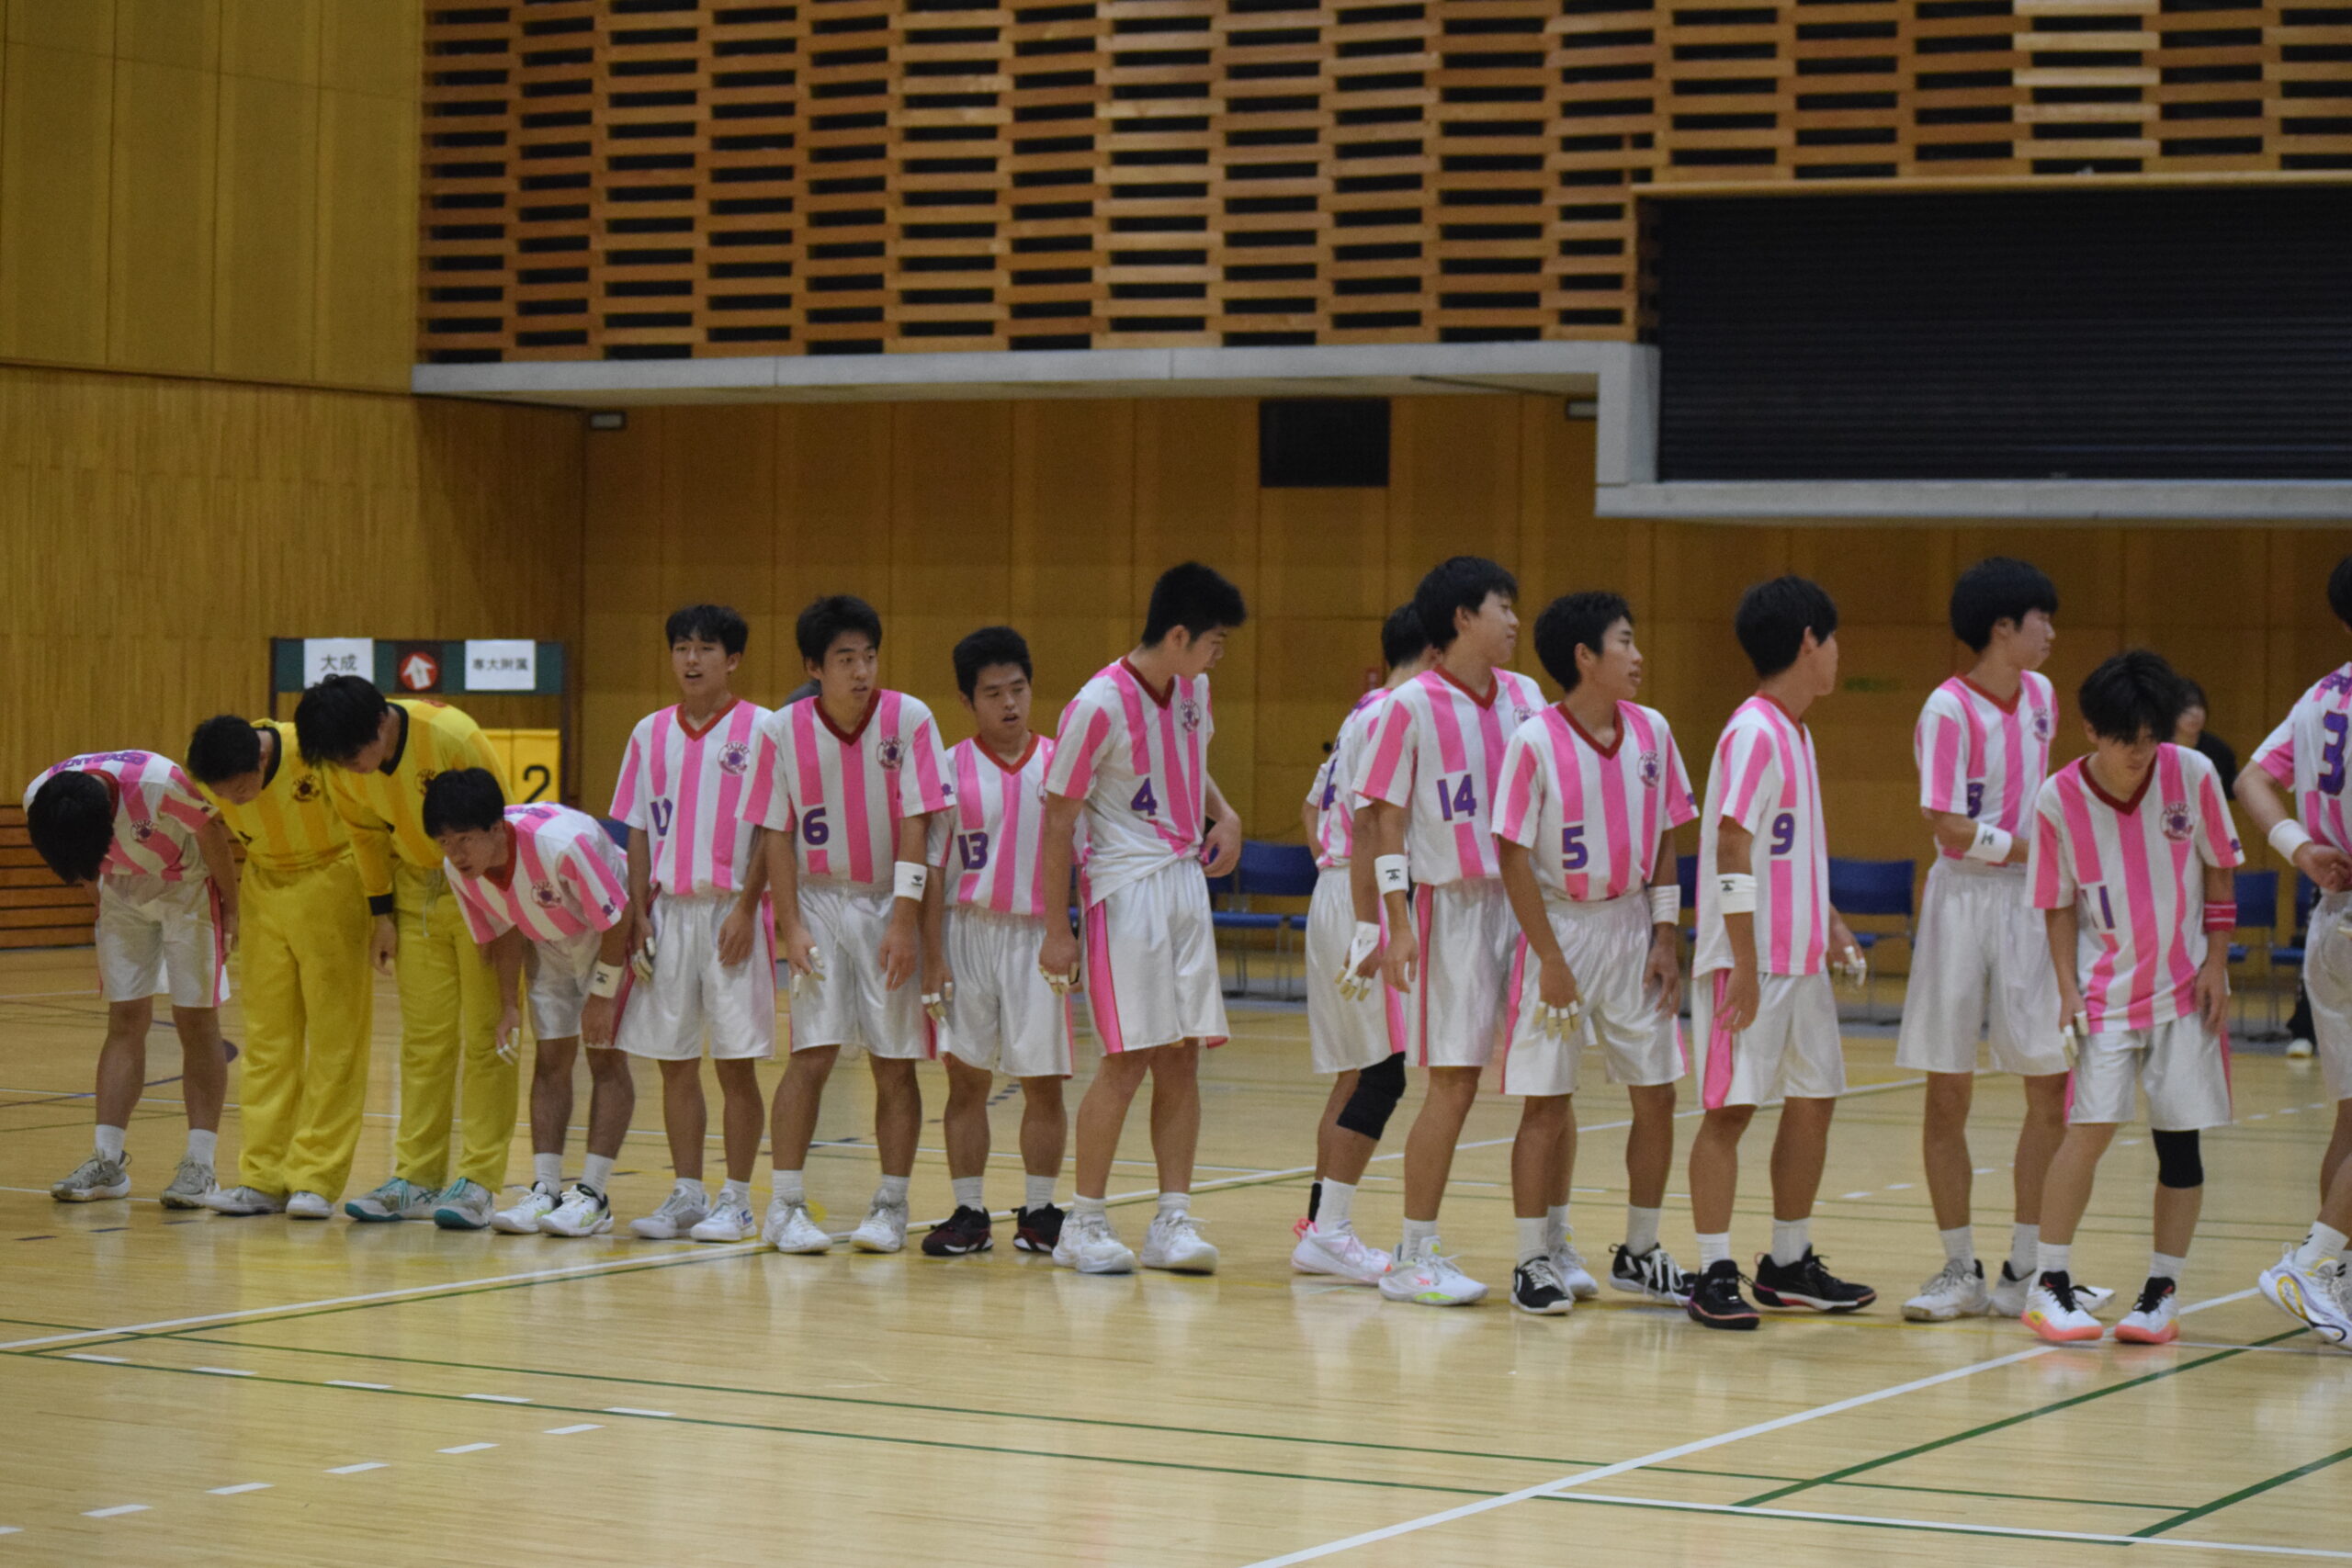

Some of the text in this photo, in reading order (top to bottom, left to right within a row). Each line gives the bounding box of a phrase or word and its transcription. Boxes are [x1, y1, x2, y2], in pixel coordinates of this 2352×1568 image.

[321, 654, 357, 671] 大成
[2317, 710, 2348, 796] 3
[523, 765, 550, 805] 2
[1131, 777, 1158, 816] 4
[1437, 774, 1476, 821] 14
[802, 807, 830, 846] 6
[1770, 812, 1795, 855] 9
[957, 831, 989, 871] 13
[1563, 825, 1588, 871] 5
